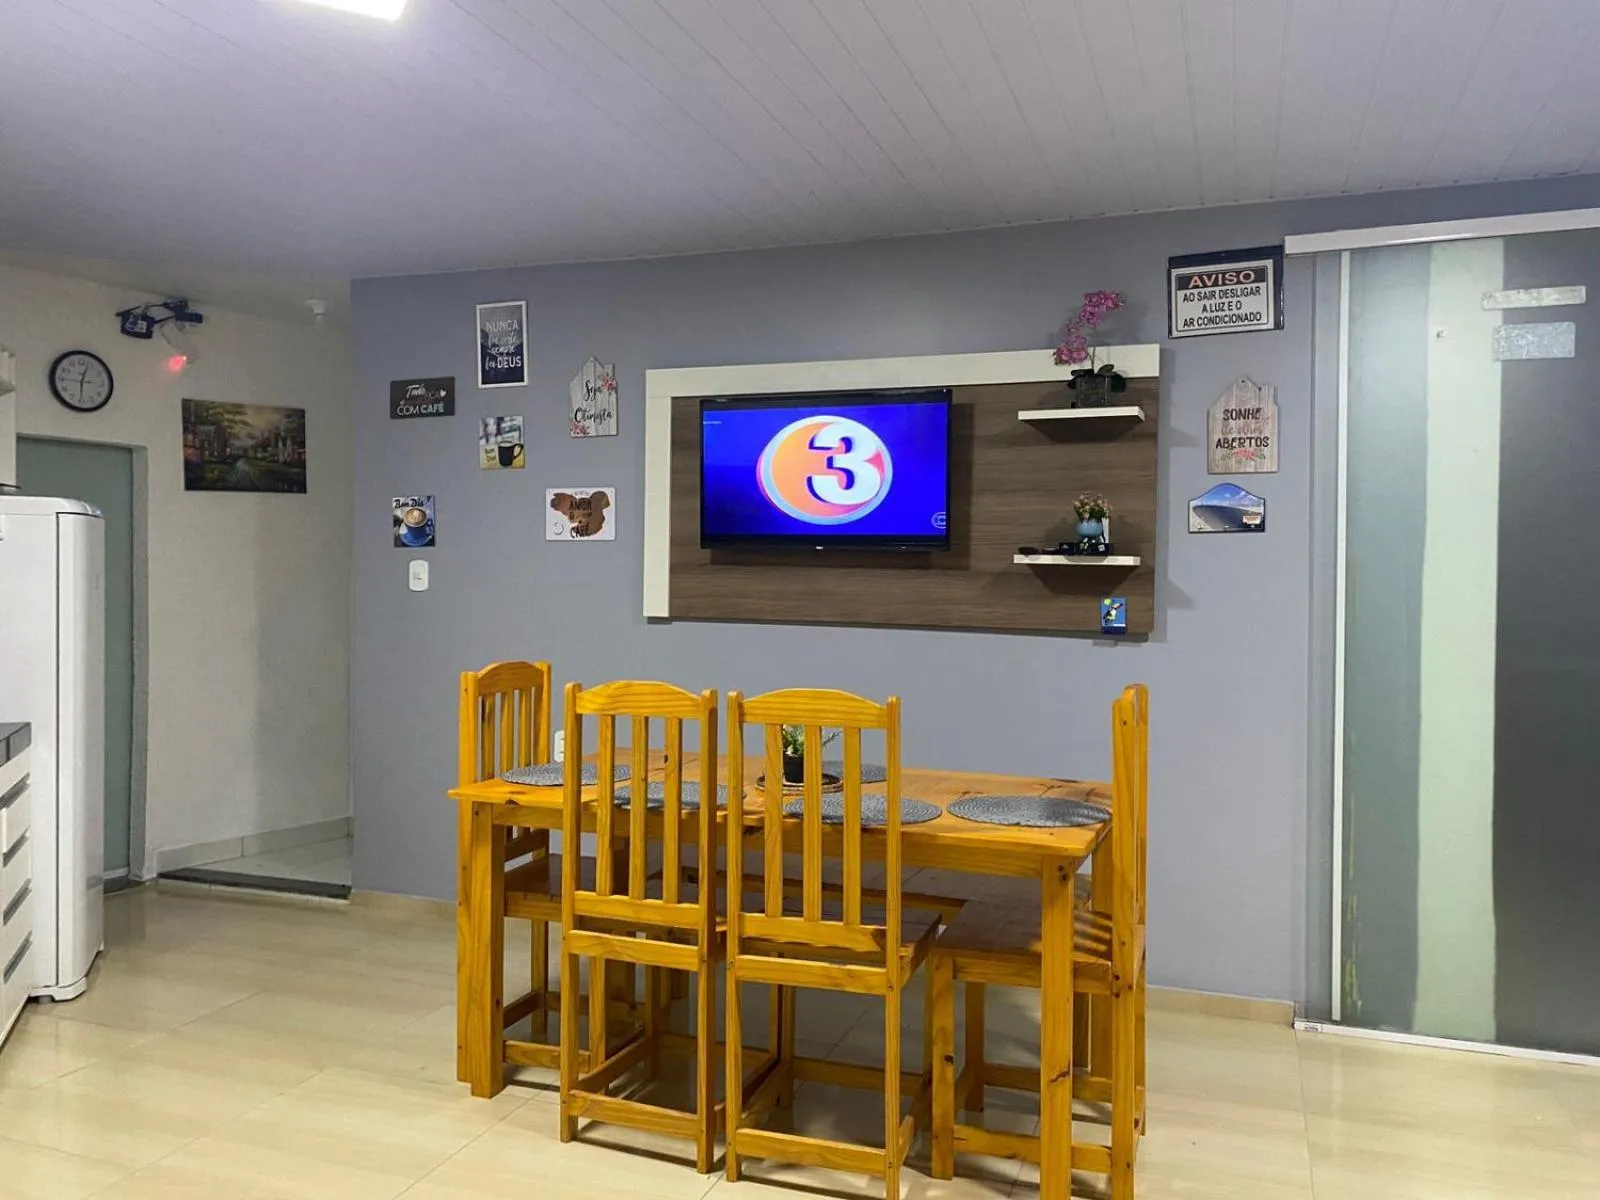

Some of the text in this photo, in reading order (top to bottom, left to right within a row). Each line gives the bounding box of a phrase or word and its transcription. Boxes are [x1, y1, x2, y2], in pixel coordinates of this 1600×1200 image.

[1188, 270, 1255, 289] AVISO
[1183, 286, 1261, 303] AO SAIR DESLIGAR
[1202, 300, 1242, 314] A LUZ E O
[486, 320, 518, 333] NUNCA
[1183, 311, 1262, 328] AR CONDICIONADO
[497, 356, 522, 369] DEUS
[397, 405, 419, 416] COM
[1222, 408, 1262, 421] SONHE
[1215, 436, 1270, 450] ABERTOS
[806, 421, 882, 505] 3
